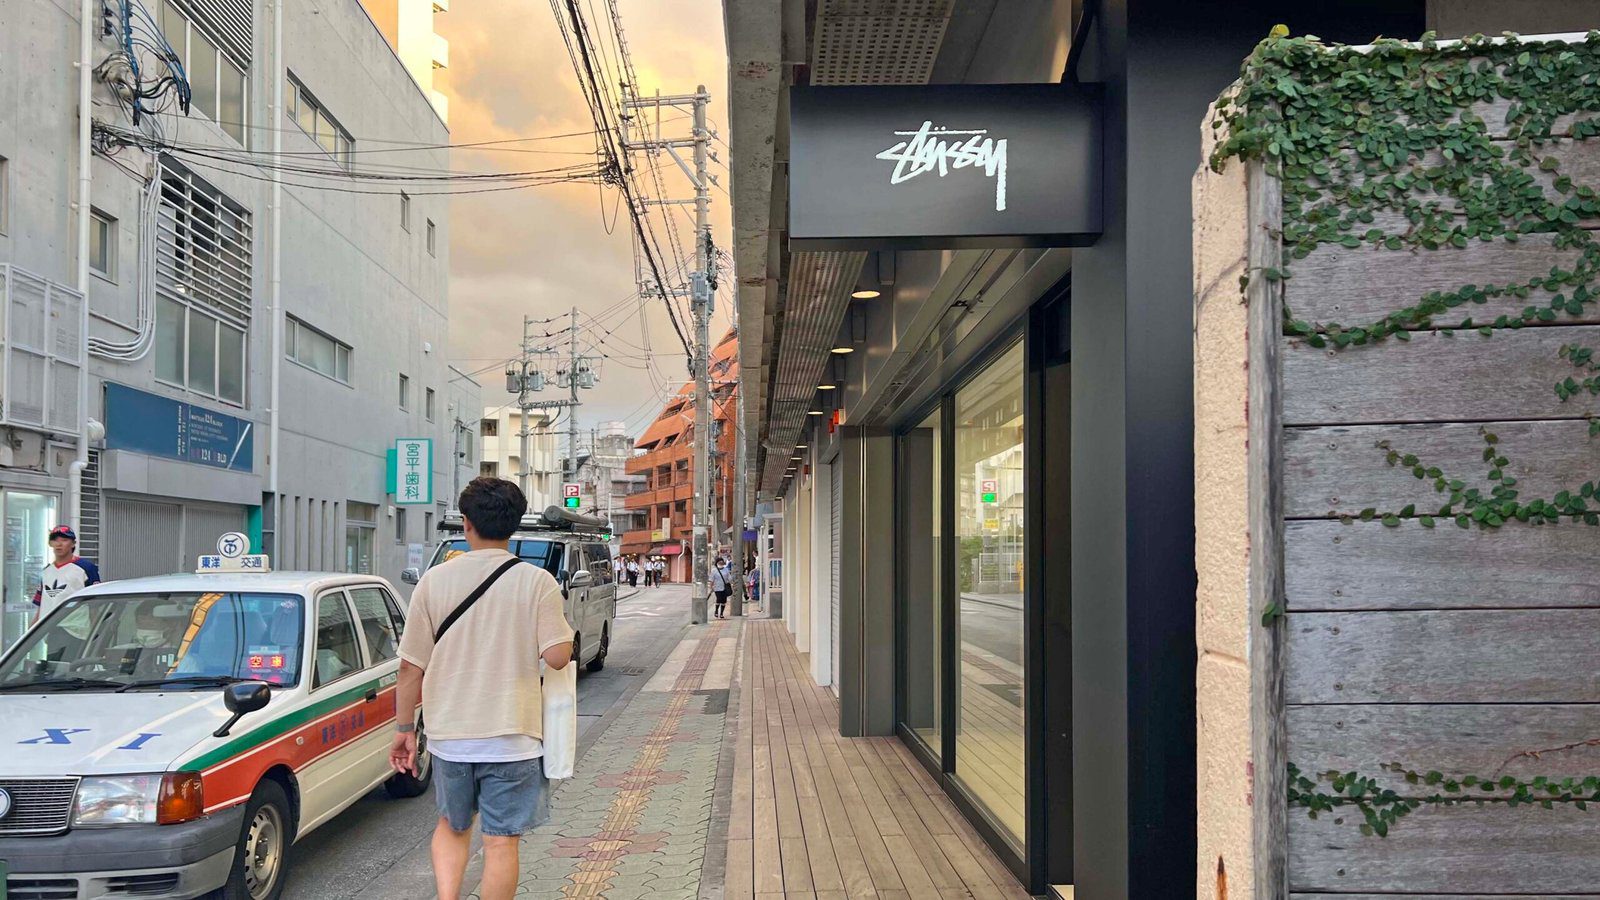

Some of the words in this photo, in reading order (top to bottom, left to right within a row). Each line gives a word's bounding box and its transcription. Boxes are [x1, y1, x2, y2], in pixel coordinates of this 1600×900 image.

[405, 442, 420, 500] 宮平歯科
[201, 556, 220, 569] 東洋
[240, 556, 262, 568] 交通
